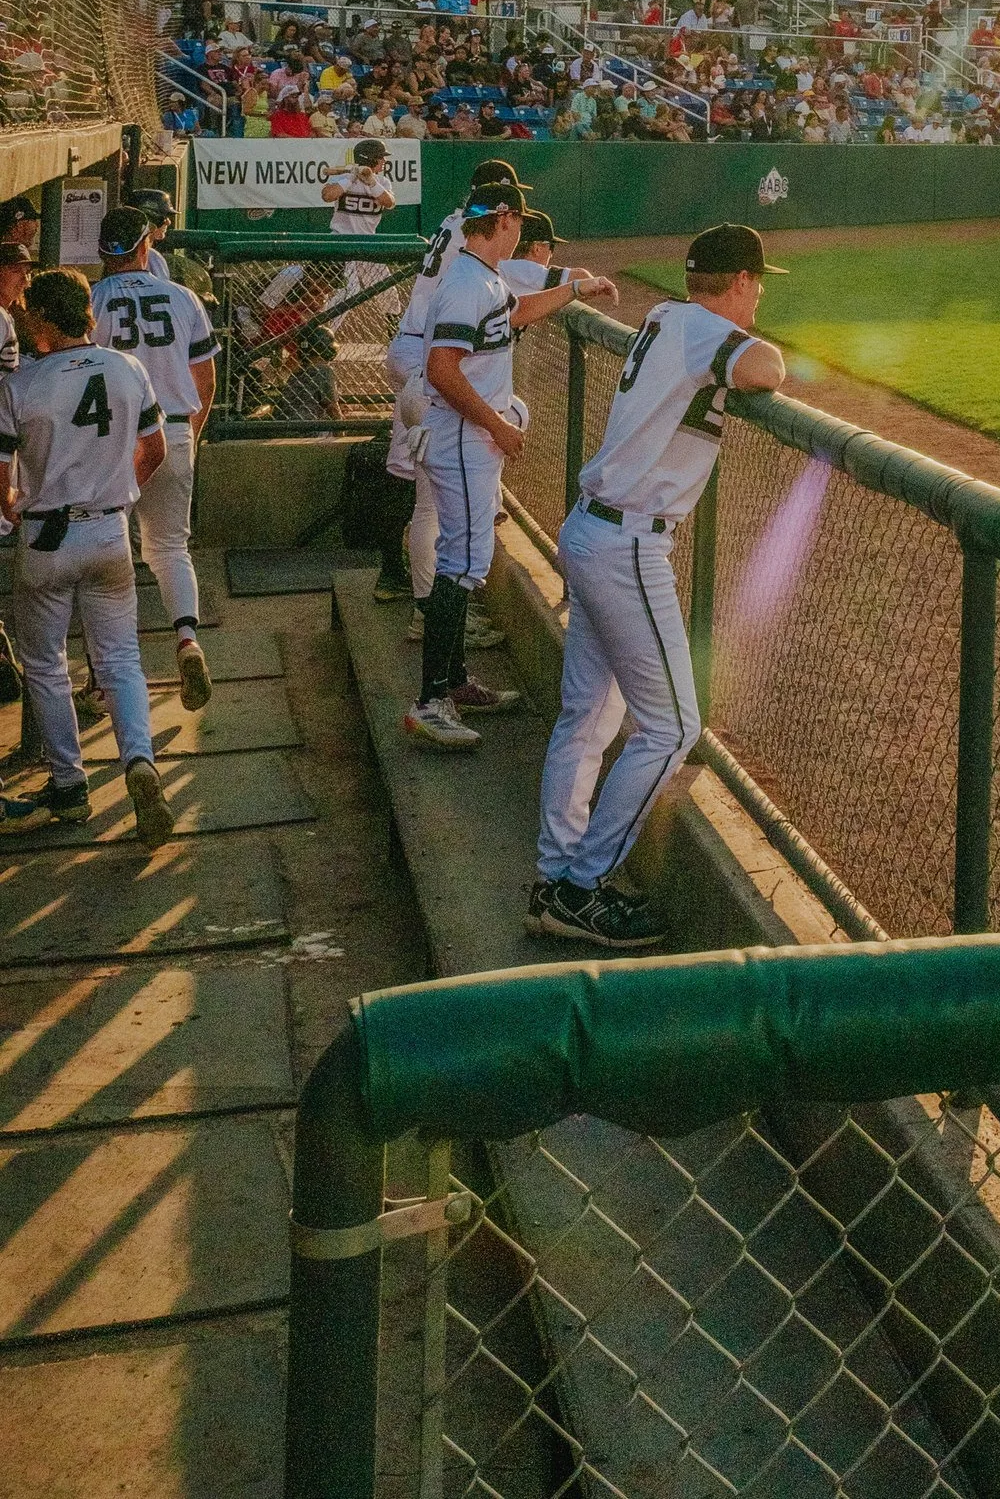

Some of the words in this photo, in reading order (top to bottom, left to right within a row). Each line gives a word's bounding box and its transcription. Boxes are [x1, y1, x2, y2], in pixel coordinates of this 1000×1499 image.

[198, 160, 248, 185] NEW
[256, 160, 330, 184] MEXICO
[384, 159, 418, 183] RUE
[760, 178, 788, 192] AABC
[106, 293, 176, 351] 35
[71, 372, 114, 438] 4
